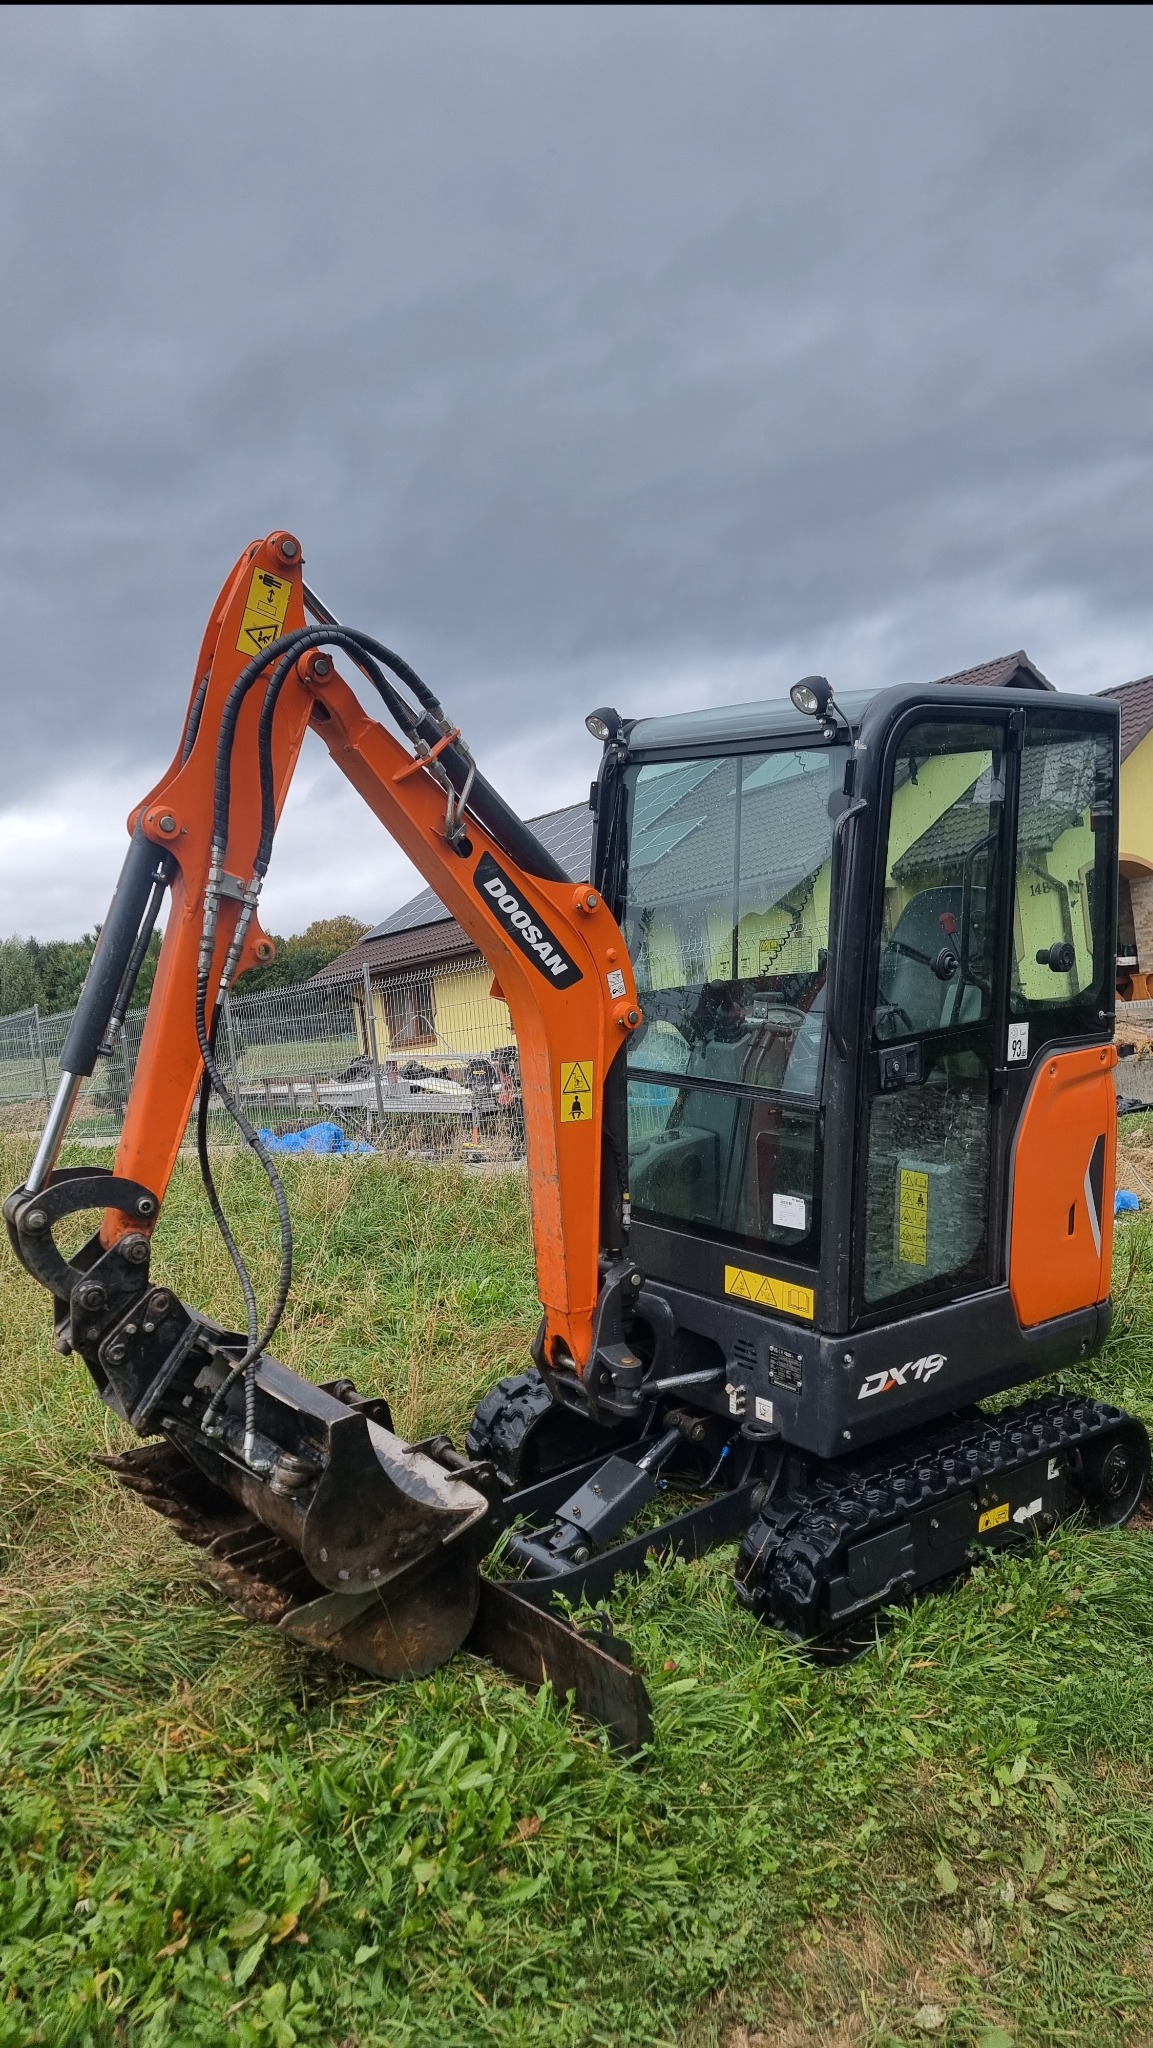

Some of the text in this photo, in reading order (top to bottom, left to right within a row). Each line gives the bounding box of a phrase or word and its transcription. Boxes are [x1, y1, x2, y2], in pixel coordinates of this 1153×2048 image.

[1029, 881, 1051, 897] 148
[483, 877, 569, 976] DOOSAN
[1012, 1039, 1022, 1057] 93
[857, 1353, 948, 1400] DX19
